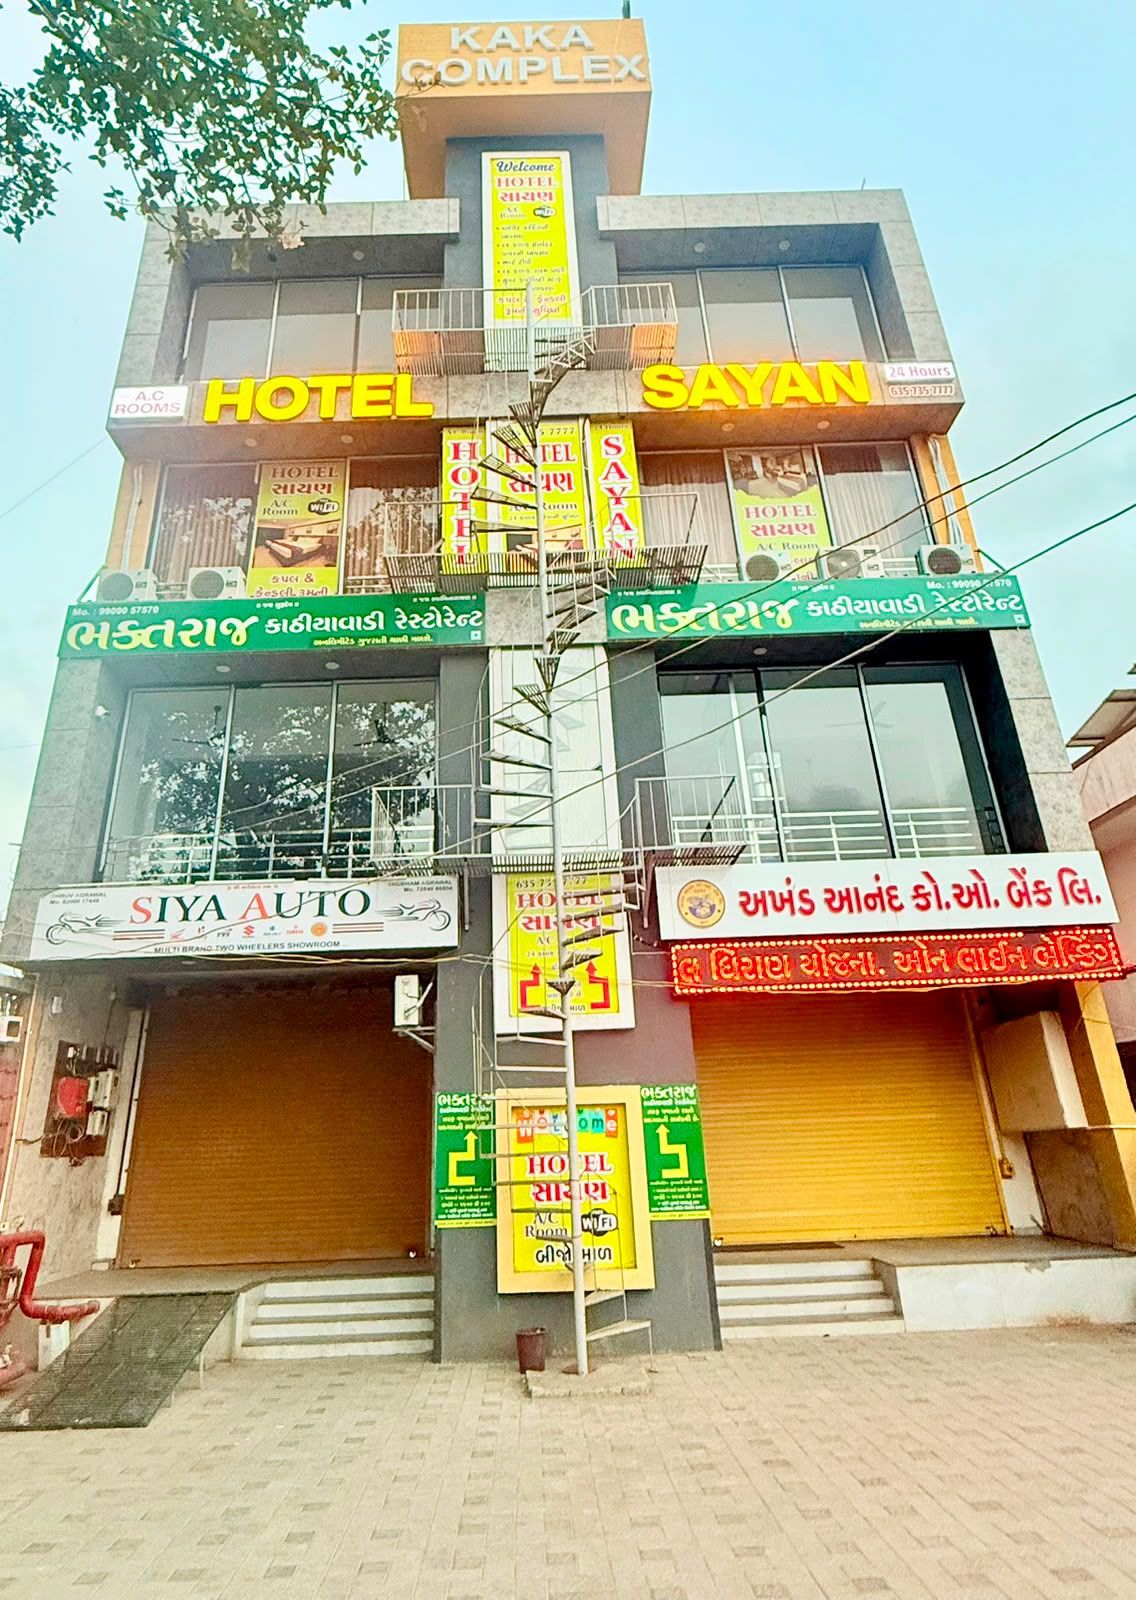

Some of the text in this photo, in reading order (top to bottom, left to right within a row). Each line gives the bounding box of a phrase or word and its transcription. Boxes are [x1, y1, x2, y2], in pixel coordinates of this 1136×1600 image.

[450, 24, 594, 52] KAKA
[401, 54, 647, 86] COMPLEX
[497, 160, 555, 172] Welcome
[497, 176, 557, 188] HOTEL
[500, 191, 553, 202] સાયણ
[889, 366, 951, 377] 24 Hours
[204, 360, 871, 423] HOTEL SAYAN
[114, 402, 181, 414] ROOMS
[505, 444, 576, 464] HTEL
[271, 466, 339, 479] HOTEL
[271, 483, 332, 495] સાયણ
[450, 441, 480, 565] HOTEL
[602, 436, 634, 560] SAYAN
[262, 507, 298, 515] Room
[745, 504, 817, 519] HOTEL
[750, 523, 816, 537] સાયણ
[782, 542, 818, 550] Room
[304, 573, 314, 583] &
[611, 600, 799, 633] ભક્તરાજ
[806, 596, 926, 617] કાઠીયાવાડી
[66, 606, 484, 651] ભક્તરાજ કાઠીયાવાડી રેસ્ટોરેન્ટ
[738, 876, 816, 917] અખંડ
[823, 873, 905, 914] આનંદ
[1006, 866, 1053, 908] બેંક
[1057, 867, 1103, 906] લિ.
[130, 888, 371, 924] SIYA AUTO
[236, 942, 285, 951] WHEELERS
[287, 940, 341, 949] SHOWROOM
[893, 938, 950, 974] ઓન
[528, 1154, 612, 1174] HOEL
[525, 1225, 567, 1237] Room
[582, 1247, 612, 1261] માળ
